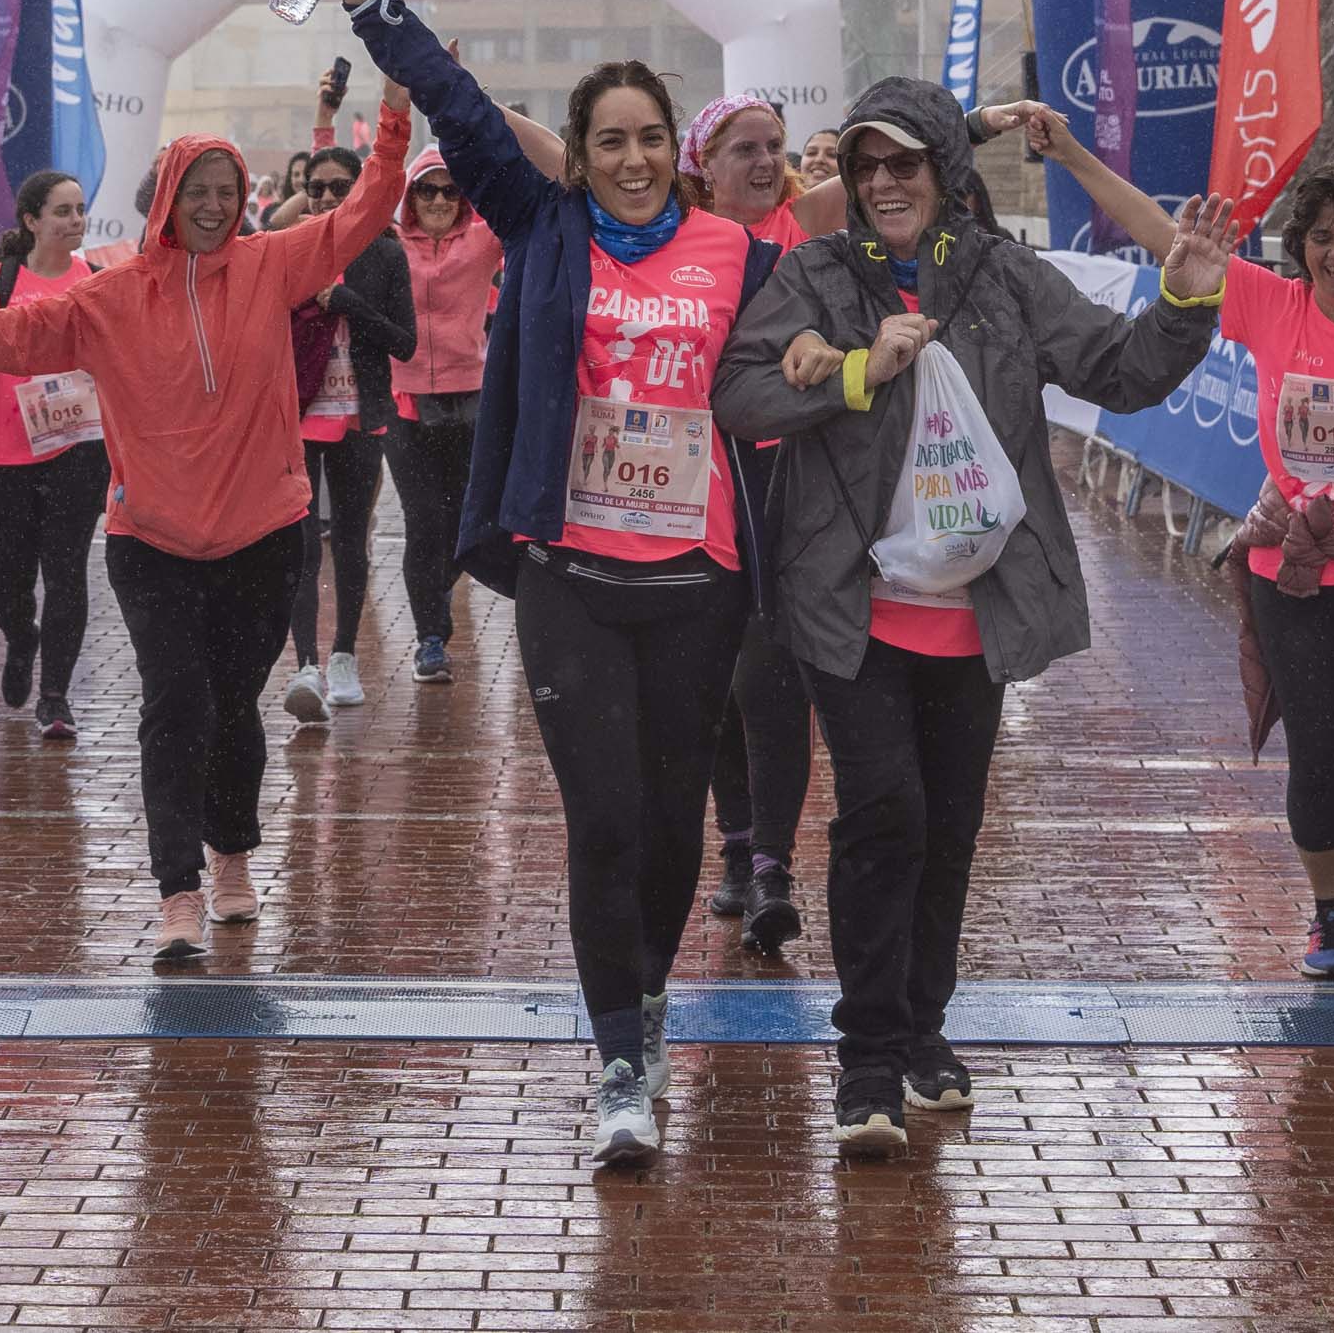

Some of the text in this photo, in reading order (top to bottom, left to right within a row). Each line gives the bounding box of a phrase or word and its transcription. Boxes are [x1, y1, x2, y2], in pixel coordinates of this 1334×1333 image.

[93, 92, 144, 115] SHO
[587, 287, 710, 332] CARRERA
[329, 375, 356, 387] 016
[52, 404, 83, 422] 016
[618, 462, 670, 486] 016
[914, 461, 990, 500] PARA MÁS
[573, 492, 603, 504] CARRERA
[605, 497, 614, 505] DE
[616, 498, 624, 506] LA
[626, 499, 649, 510] MUJER
[673, 505, 700, 514] CANARIA
[629, 488, 655, 499] 2456
[928, 500, 975, 531] VIDA
